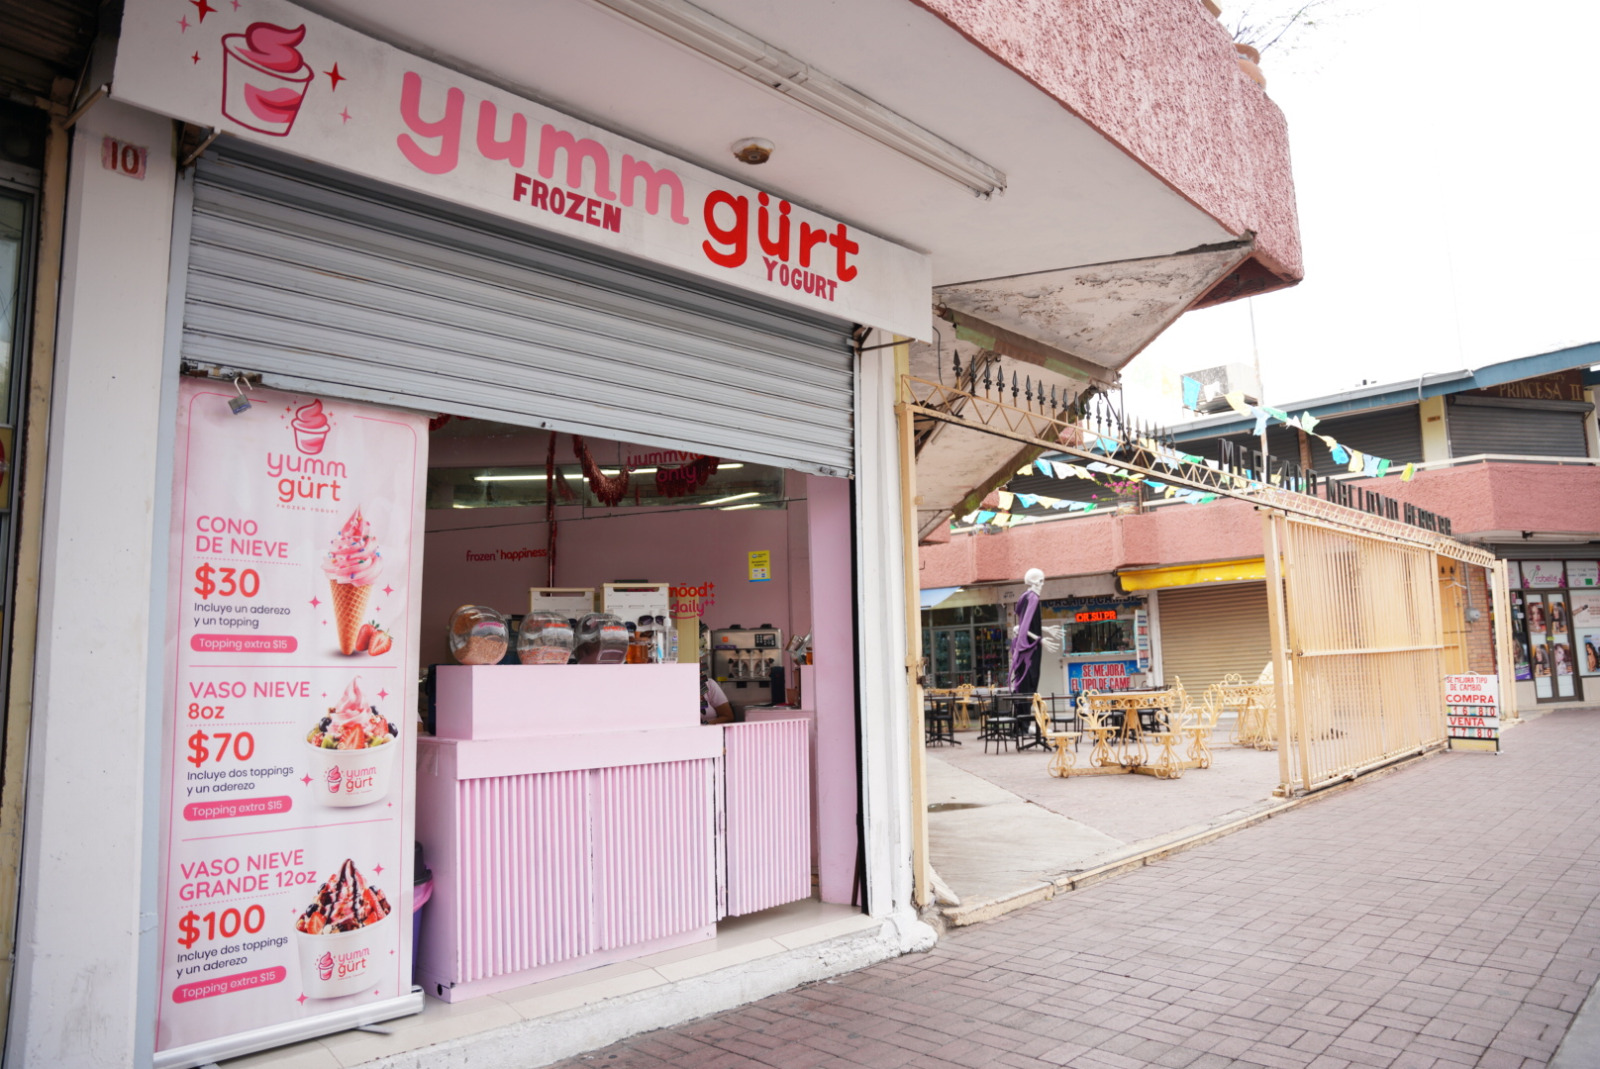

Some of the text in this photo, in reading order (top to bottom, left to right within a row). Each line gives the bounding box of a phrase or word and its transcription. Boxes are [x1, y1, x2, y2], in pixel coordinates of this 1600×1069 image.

[109, 140, 140, 175] 10
[397, 71, 859, 282] yumm gürt
[513, 173, 622, 234] FROZEN
[763, 256, 838, 302] YOGURT
[1500, 381, 1583, 400] PRINCESA II
[267, 452, 347, 479] yumm
[657, 465, 697, 484] only
[278, 475, 341, 503] gürt
[196, 515, 258, 536] CONO
[196, 535, 288, 558] DE NIEVE
[194, 562, 260, 600] $30
[194, 602, 291, 615] Incluye un aderezo
[671, 599, 705, 617] daily
[193, 617, 259, 629] y un topping
[199, 638, 288, 651] Topping extra $15
[1082, 663, 1125, 677] SE MEJORA
[189, 681, 310, 698] VASO NIEVE
[1071, 678, 1079, 691] EL
[1081, 678, 1098, 690] TIPO
[1099, 677, 1107, 689] DE
[1447, 676, 1488, 684] SE MEJORA TIPO
[1450, 683, 1457, 691] DE
[1445, 694, 1494, 703] COMPRA
[188, 702, 225, 720] 8oz
[1449, 716, 1485, 726] VENTA
[187, 729, 254, 768] $70
[187, 766, 294, 781] Incluye dos toppings
[346, 766, 376, 780] yumm
[186, 782, 255, 797] y un aderezo
[346, 776, 373, 793] gürt
[192, 800, 282, 818] Topping extra $15
[181, 849, 304, 880] VASO NIEVE
[179, 870, 317, 901] GRANDE 12oz
[177, 904, 265, 949] $100
[177, 937, 288, 963] Incluye dos toppings
[338, 948, 370, 964] yumm
[176, 956, 247, 979] y un aderezo
[338, 958, 366, 977] gürt
[182, 971, 276, 998] Topping extra $15
